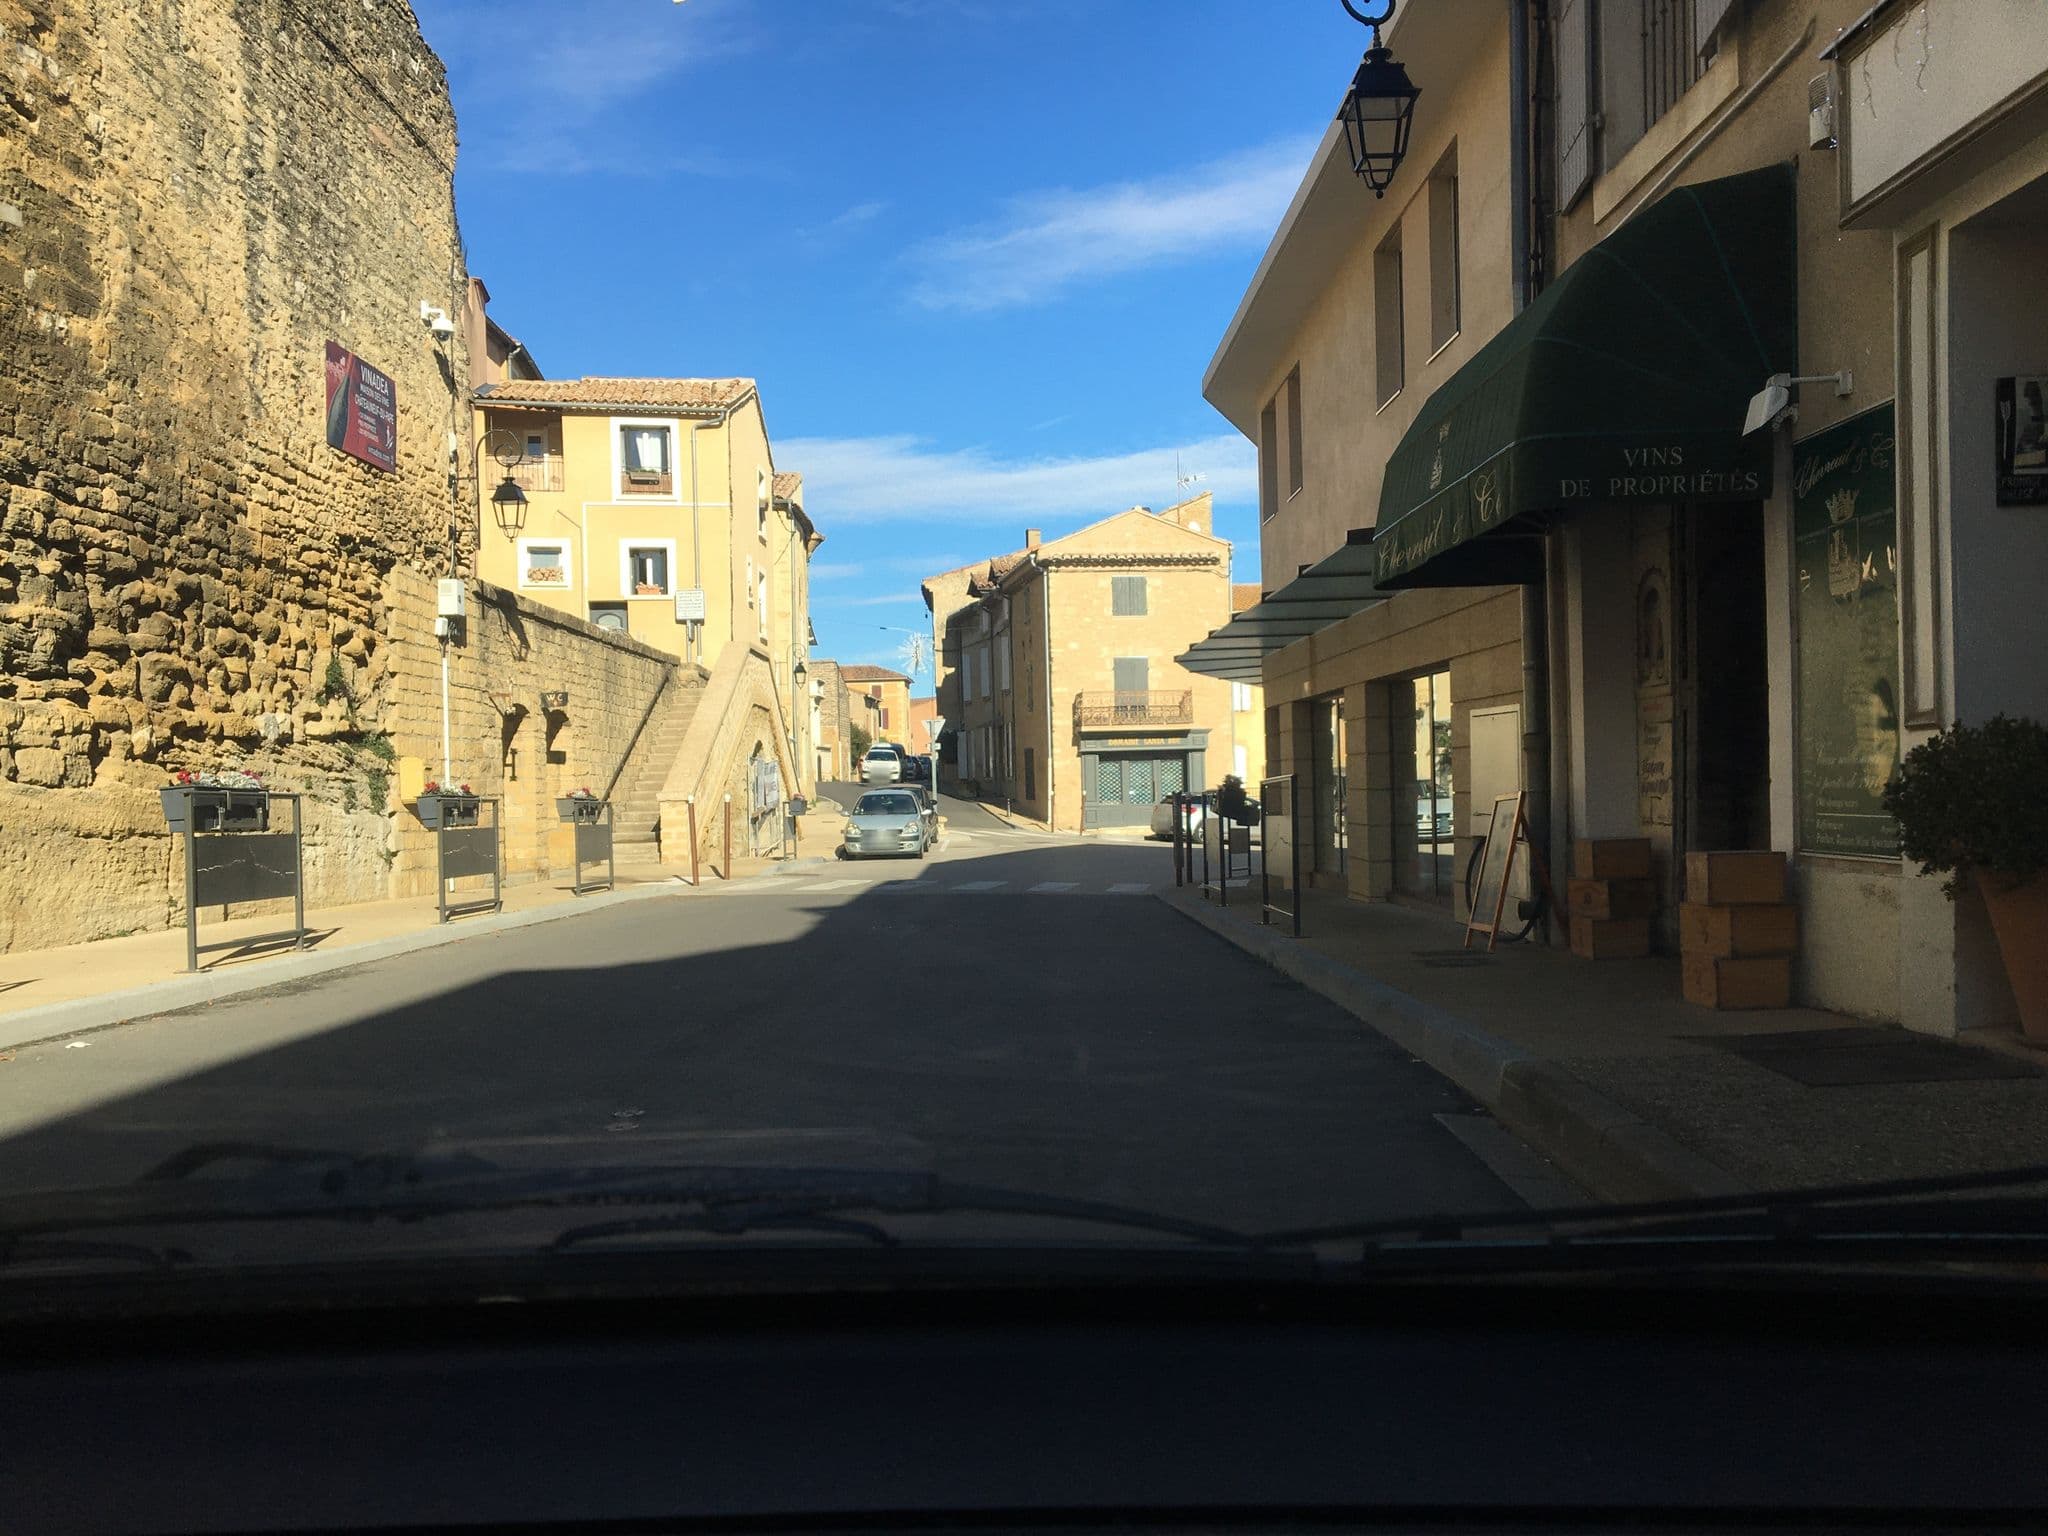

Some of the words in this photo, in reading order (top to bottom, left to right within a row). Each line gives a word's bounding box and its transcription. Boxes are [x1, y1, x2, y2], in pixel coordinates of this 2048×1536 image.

[360, 365, 389, 397] VINADEA
[1623, 447, 1683, 467] VINS
[1560, 478, 1592, 498] DE
[1608, 467, 1760, 497] PROPRIÉTÉS
